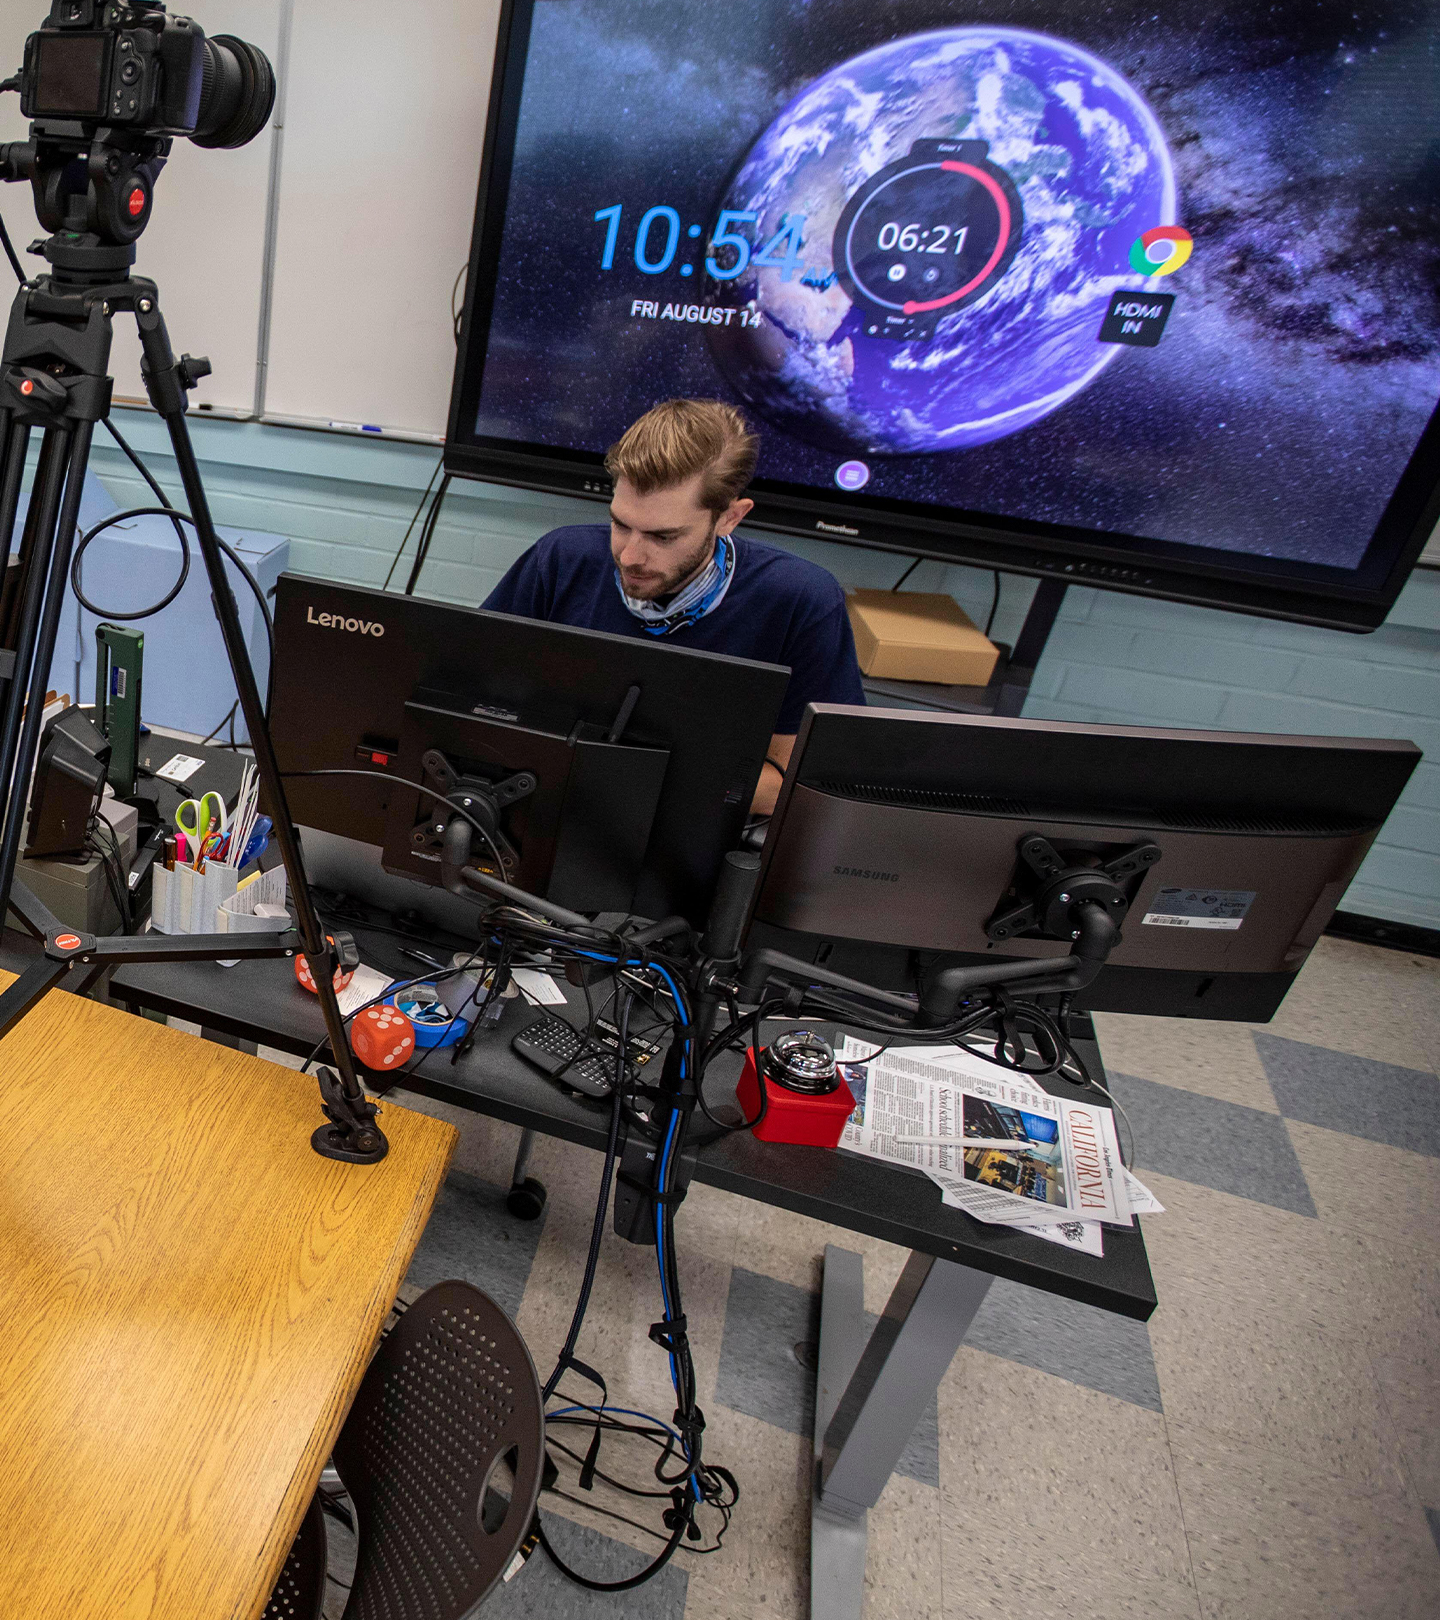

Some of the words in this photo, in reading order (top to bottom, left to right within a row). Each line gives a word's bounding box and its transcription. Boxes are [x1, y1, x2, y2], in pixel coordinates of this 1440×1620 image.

[594, 204, 807, 283] 10:54
[877, 222, 969, 255] 06:21
[630, 300, 659, 319] FRI
[660, 303, 736, 326] AUGUST
[739, 311, 762, 329] 14
[1113, 301, 1163, 319] HDMI
[1121, 320, 1143, 335] IN
[816, 520, 859, 536] Promethean
[307, 606, 385, 637] Lenovo
[833, 866, 900, 882] SAMSUNG
[939, 1088, 952, 1111] School
[939, 1144, 952, 1171] inalized
[1068, 1109, 1106, 1209] CALIFORNIA
